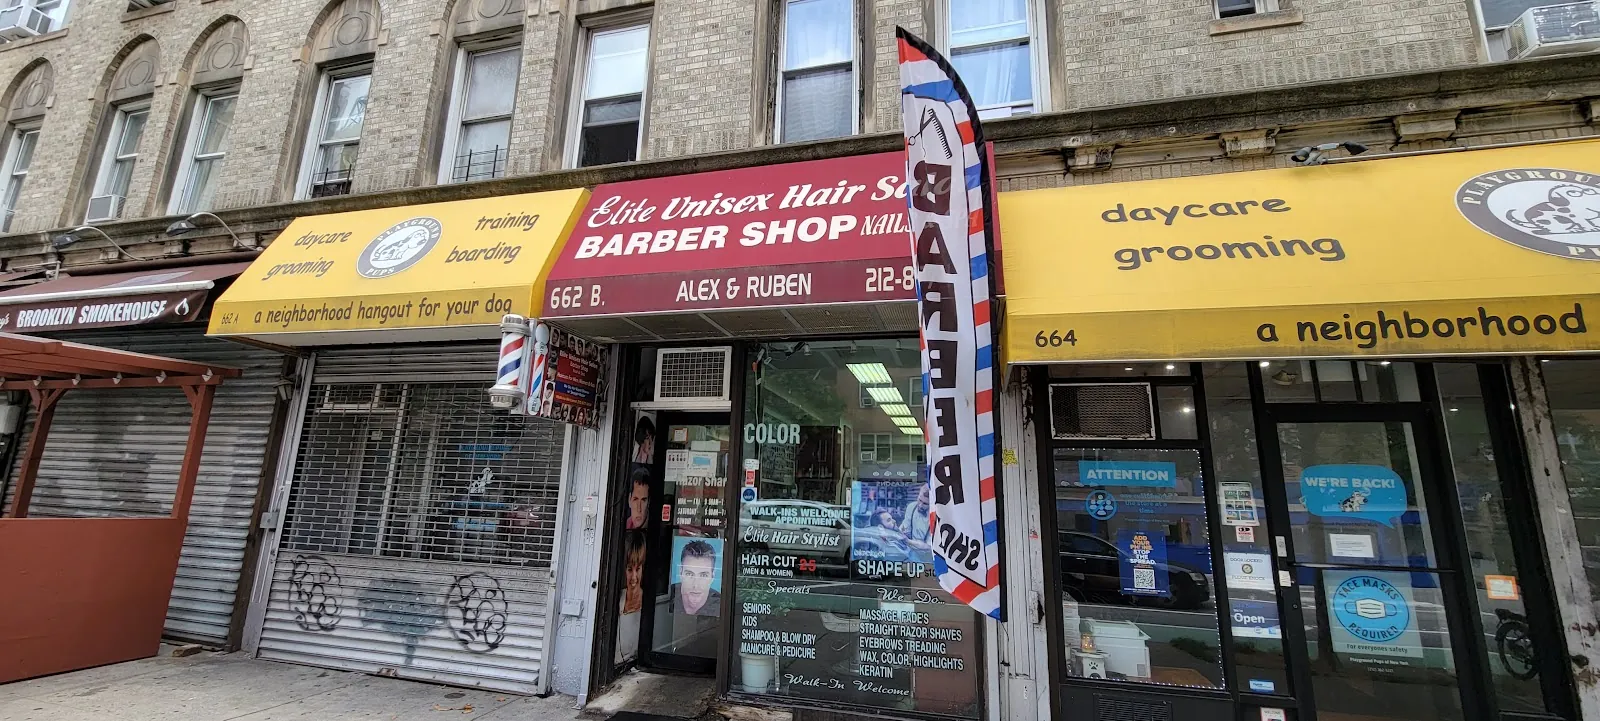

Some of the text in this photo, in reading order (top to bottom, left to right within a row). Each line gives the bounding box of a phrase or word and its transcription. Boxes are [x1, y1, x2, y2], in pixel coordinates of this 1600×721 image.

[1462, 170, 1600, 206] PLAYGROU
[588, 195, 655, 228] Elite
[661, 191, 775, 221] Unisex
[778, 173, 866, 210] Hair
[1101, 197, 1292, 226] daycare
[376, 218, 440, 241] PLAYGROUND
[475, 212, 540, 232] training
[294, 230, 352, 249] daycare
[574, 224, 736, 260] BARBER
[738, 214, 858, 247] SHOP
[445, 243, 521, 264] boarding
[1115, 233, 1346, 271] grooming
[261, 256, 334, 281] grooming
[365, 267, 395, 276] PUPS
[676, 273, 812, 303] ALEX & RUBEN
[865, 265, 915, 293] 212-8
[551, 284, 606, 308] 662 B.
[17, 306, 77, 328] BROOKLYN
[78, 299, 167, 325] SMOKEHOUSE
[221, 312, 240, 325] 662 A
[254, 292, 513, 328] a neighborhood hangout for your dog
[1256, 303, 1588, 350] a neighborhood
[1035, 329, 1078, 348] 664
[744, 423, 800, 445] COLOR
[1087, 469, 1169, 482] ATTENTION
[1305, 477, 1396, 489] WE'RE BACK!
[750, 507, 850, 519] WALK-INS WELCOME
[775, 516, 836, 526] APPOINTMENT
[743, 525, 840, 548] Elite Hair Stylist
[741, 553, 770, 567] HAIR
[772, 556, 798, 568] CUT
[858, 559, 902, 577] SHAPE
[906, 562, 925, 578] UP
[743, 567, 759, 576] (MEN
[766, 569, 794, 578] WOMEN)
[767, 580, 811, 595] Specials
[876, 588, 904, 601] We
[1338, 578, 1400, 600] FACE MASKS
[742, 602, 771, 614] SENIORS
[860, 608, 899, 623] MASSAGE,
[742, 615, 758, 627] KIDS
[1233, 612, 1266, 625] Open
[741, 628, 817, 646] SHAMPOO & BLOW DRY
[860, 623, 962, 641] STRAIGHT RAZOR SHAVES
[1348, 622, 1399, 640] REQUIRED
[741, 642, 816, 659] MANICURE & PEDICURE
[860, 636, 946, 654] EYEBROWS TREADING
[1389, 646, 1408, 654] safety
[860, 651, 964, 671] WAX, COLOR, HIGHLIGHTS
[860, 664, 893, 679] KERATIN
[784, 673, 909, 696] Walk-In Welcome
